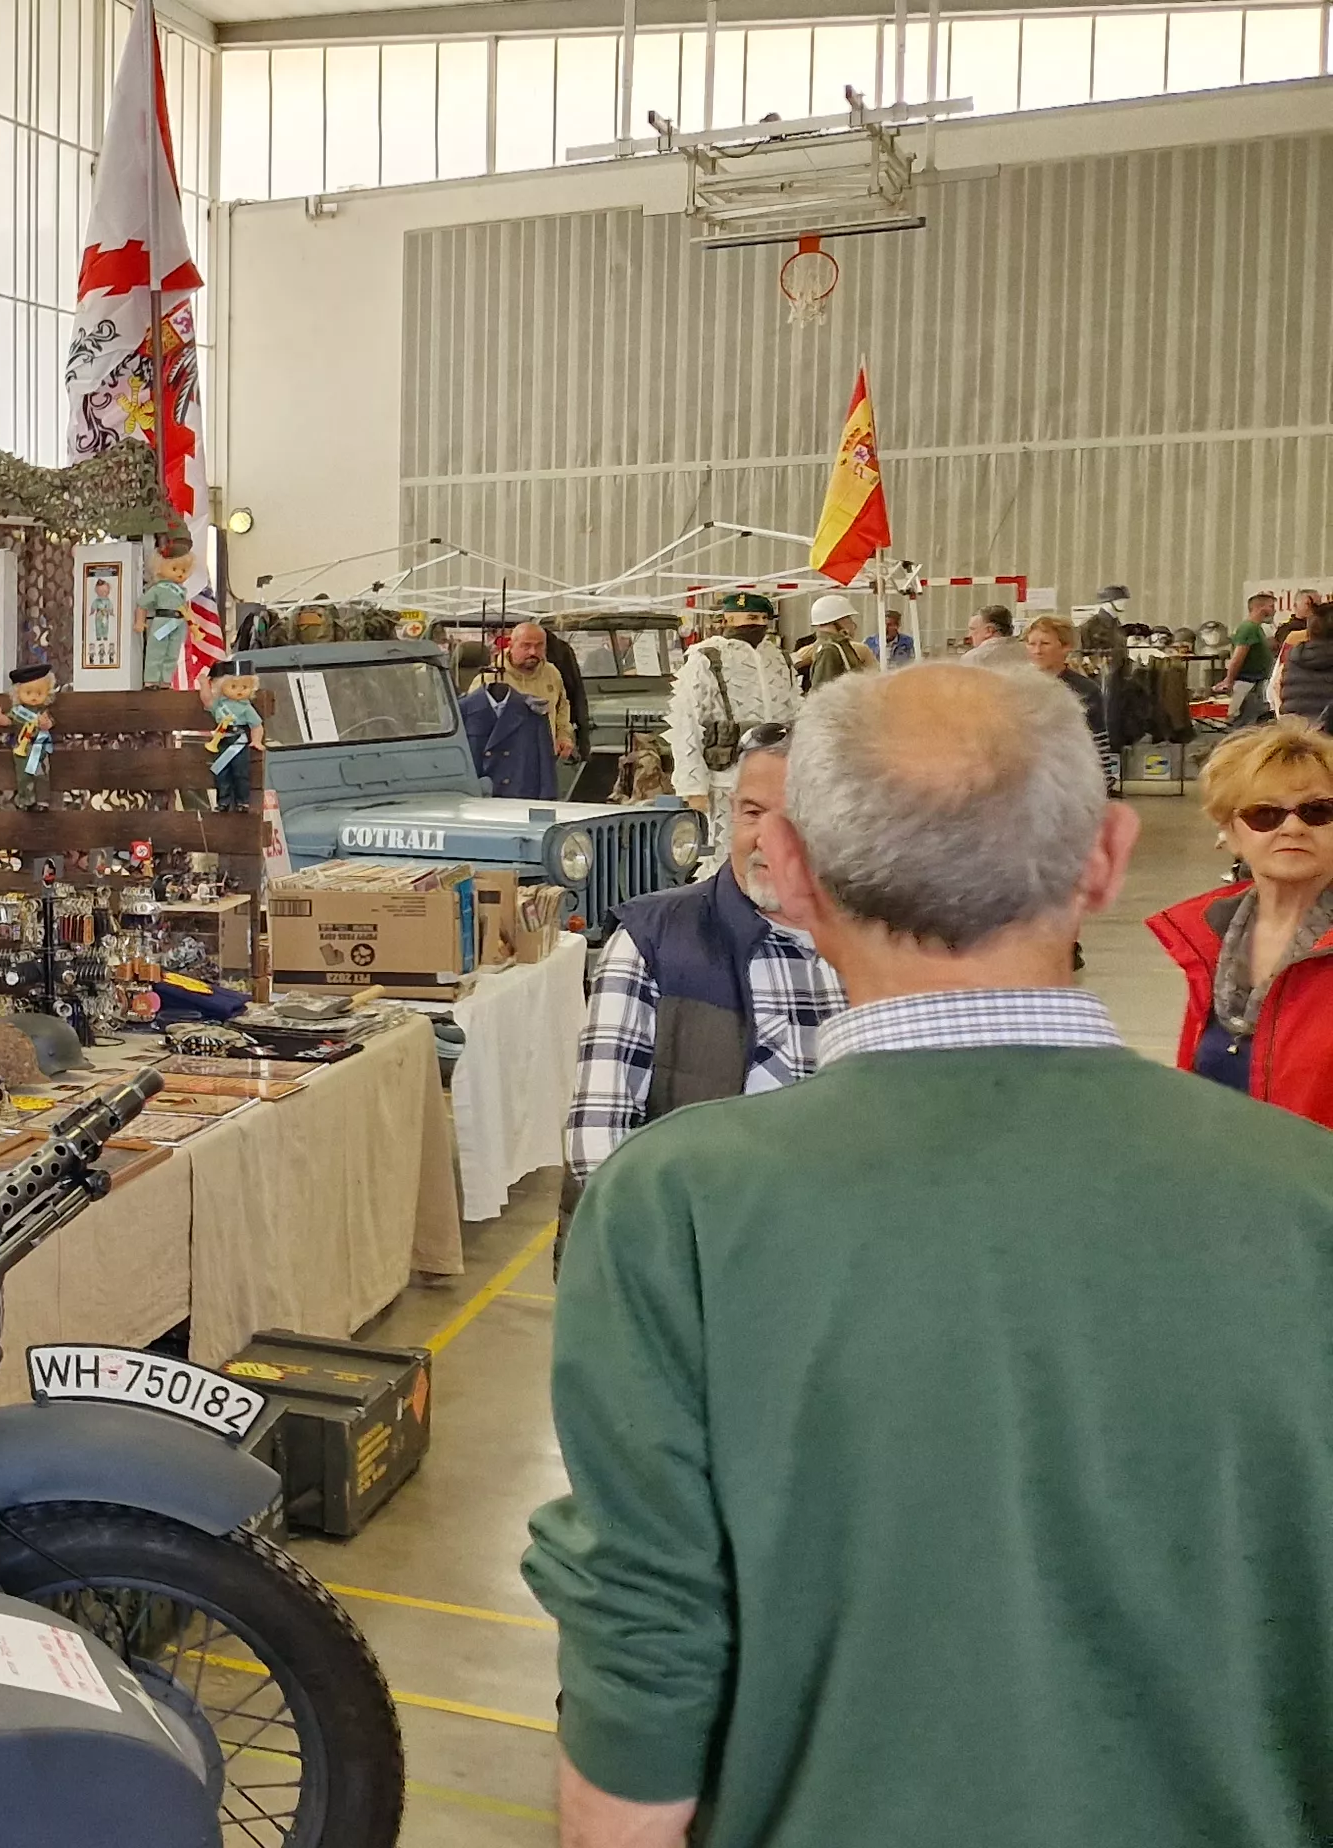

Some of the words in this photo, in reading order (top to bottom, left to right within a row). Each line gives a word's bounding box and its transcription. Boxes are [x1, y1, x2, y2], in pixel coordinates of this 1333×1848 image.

[341, 826, 446, 851] COTRALI
[326, 973, 352, 984] 2023
[352, 973, 371, 984] PET
